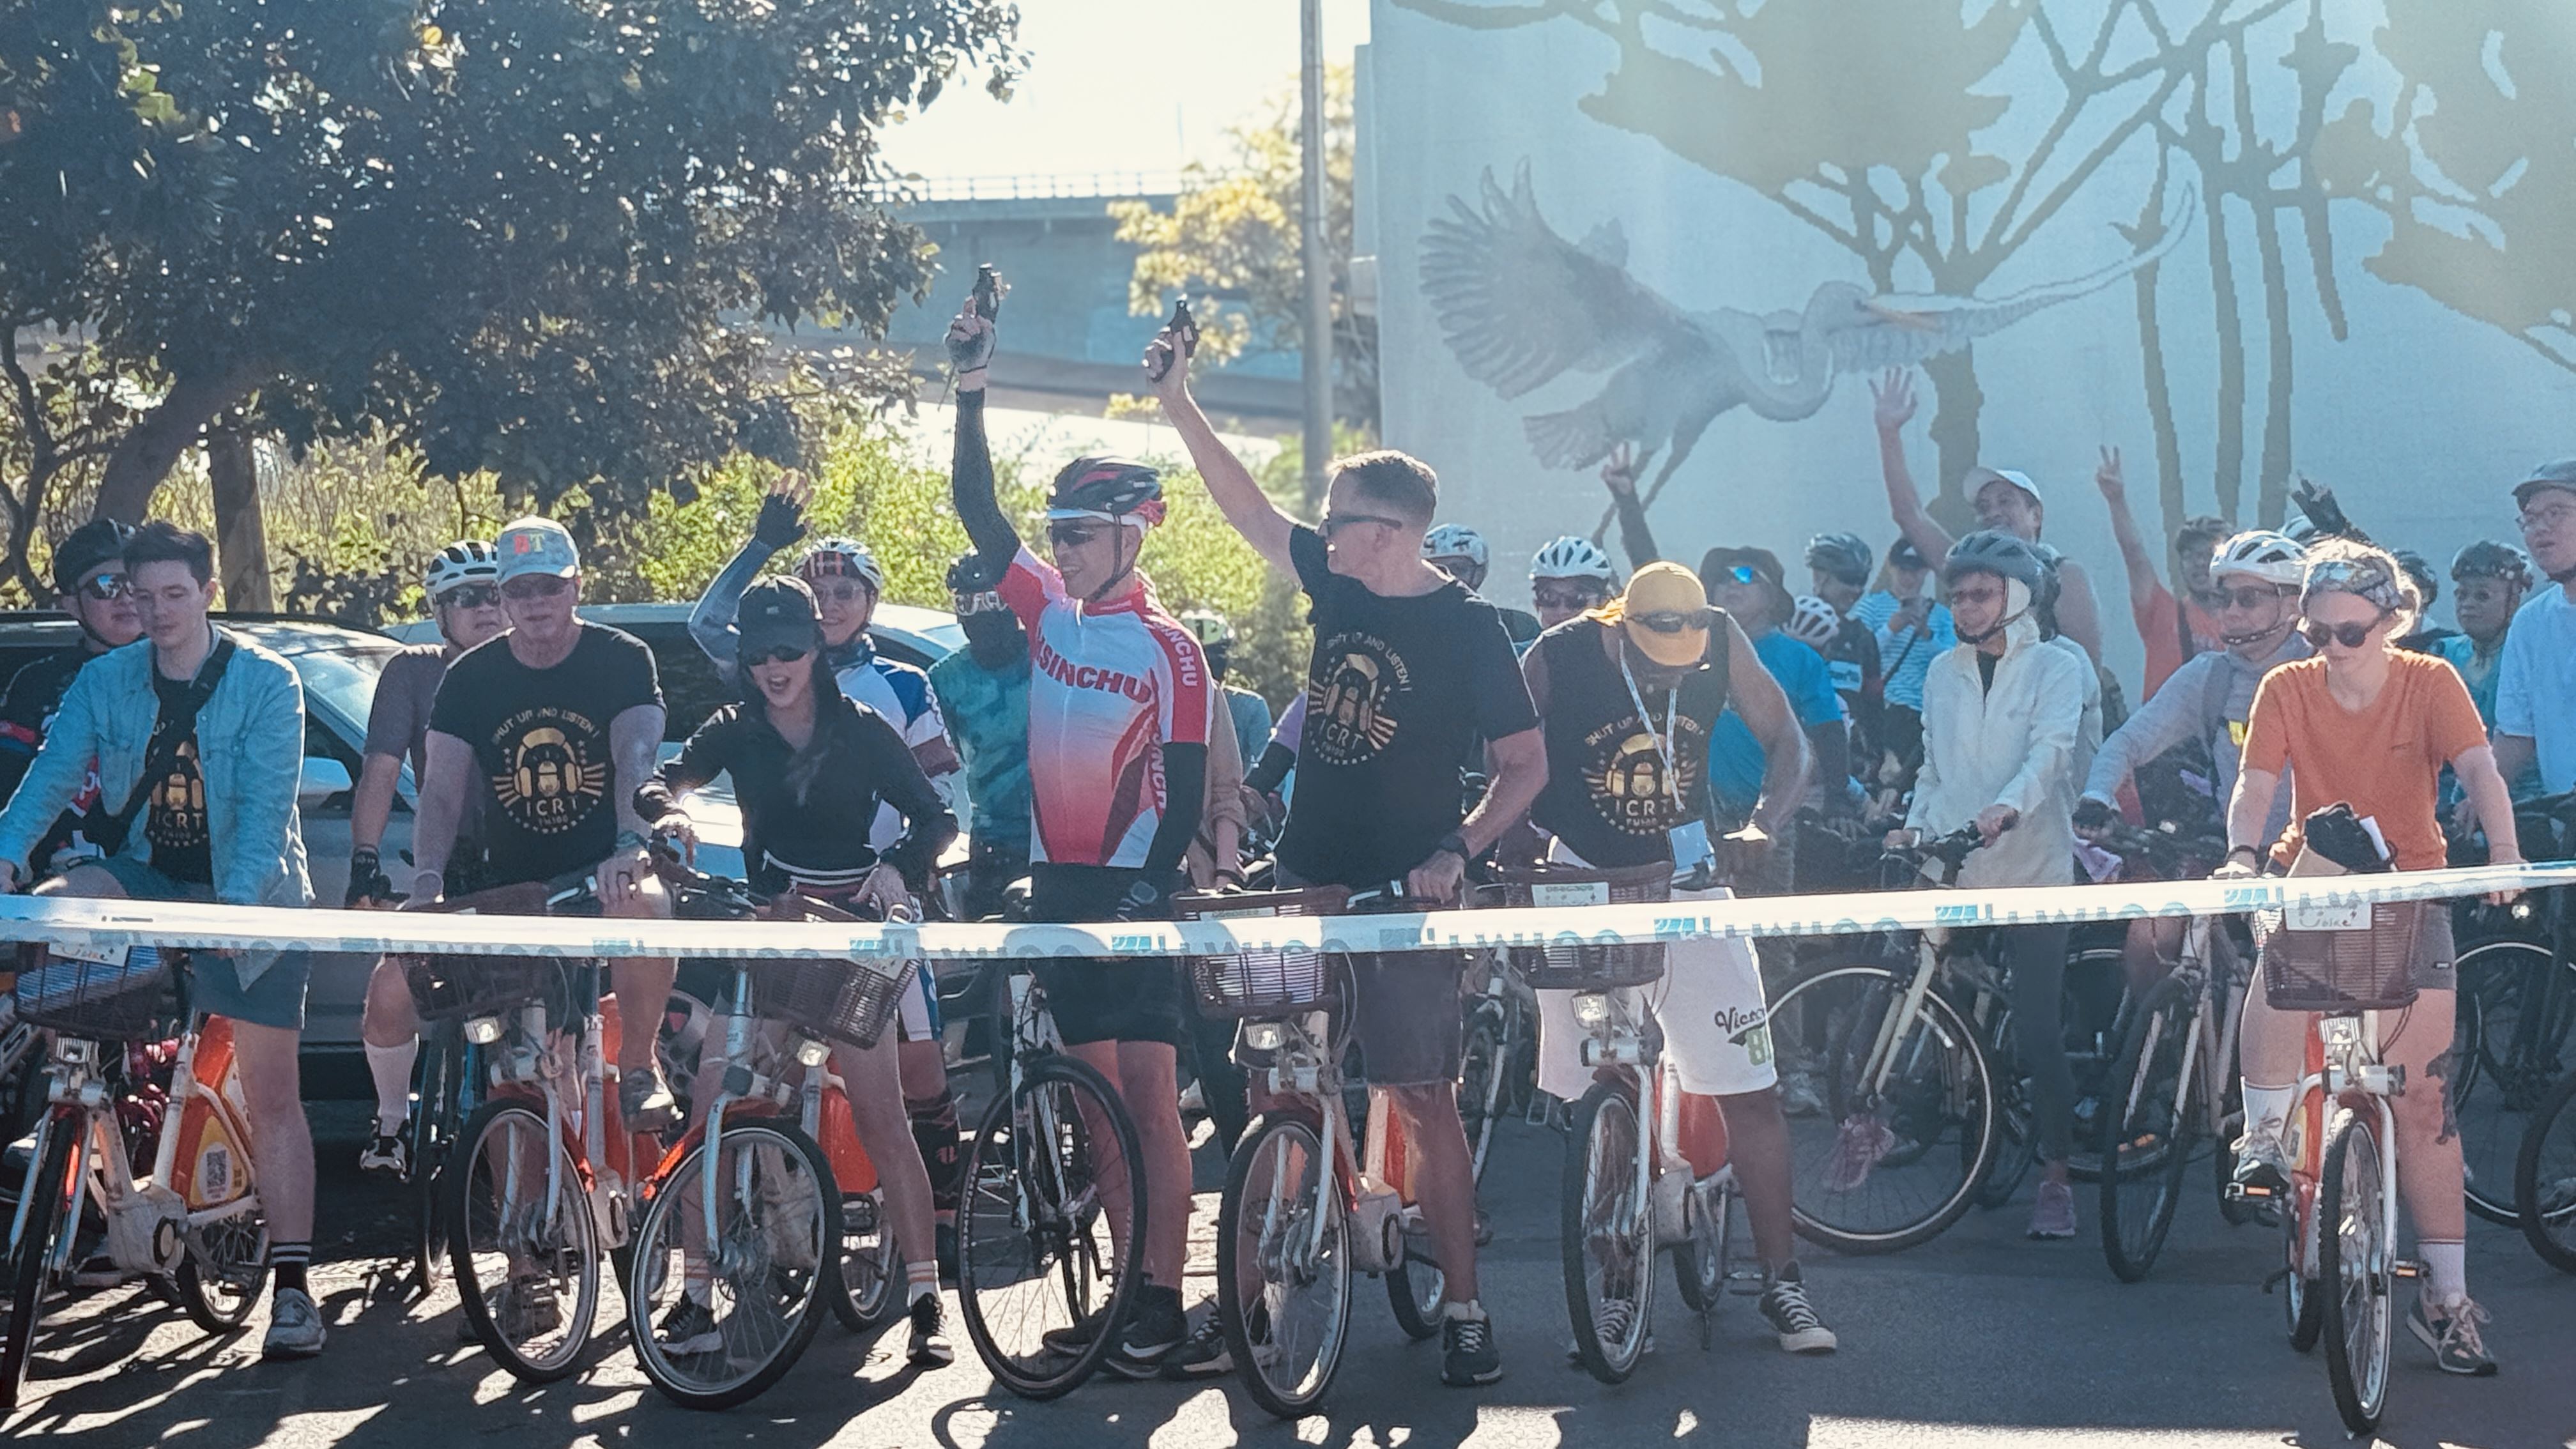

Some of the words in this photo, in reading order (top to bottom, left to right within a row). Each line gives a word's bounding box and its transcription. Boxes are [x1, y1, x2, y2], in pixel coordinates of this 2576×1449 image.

[1038, 626, 1152, 703] SINCHU
[1319, 718, 1364, 751] ICRT
[155, 812, 203, 830] ICRT
